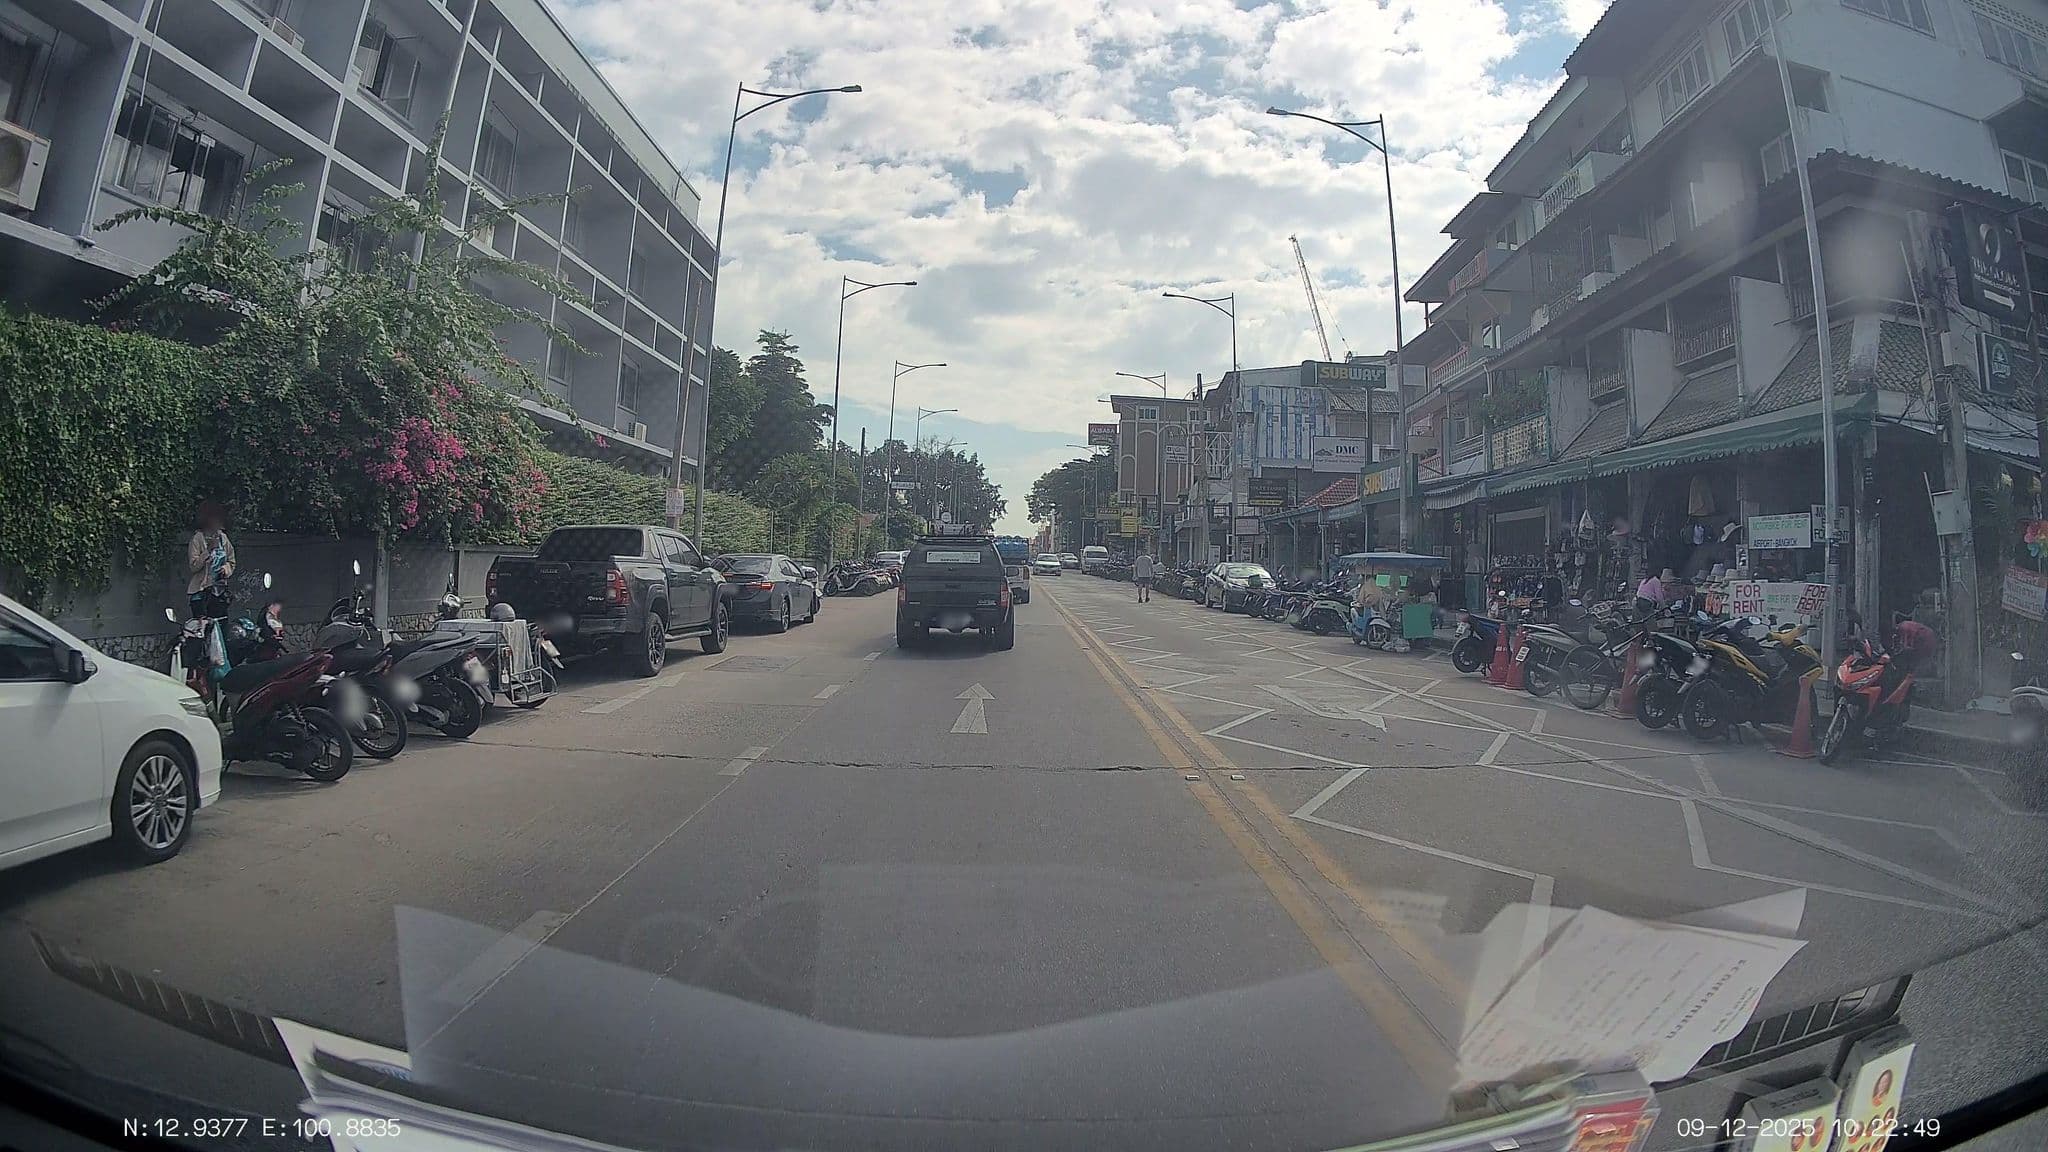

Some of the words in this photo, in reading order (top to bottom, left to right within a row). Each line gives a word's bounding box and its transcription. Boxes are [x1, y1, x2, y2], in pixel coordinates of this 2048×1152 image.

[1319, 366, 1382, 382] SUBWAY
[1335, 445, 1360, 455] DMC
[1735, 584, 1761, 598] FOR
[1804, 584, 1828, 598] FOR
[1733, 599, 1765, 614] RENT
[1796, 597, 1826, 611] RENT
